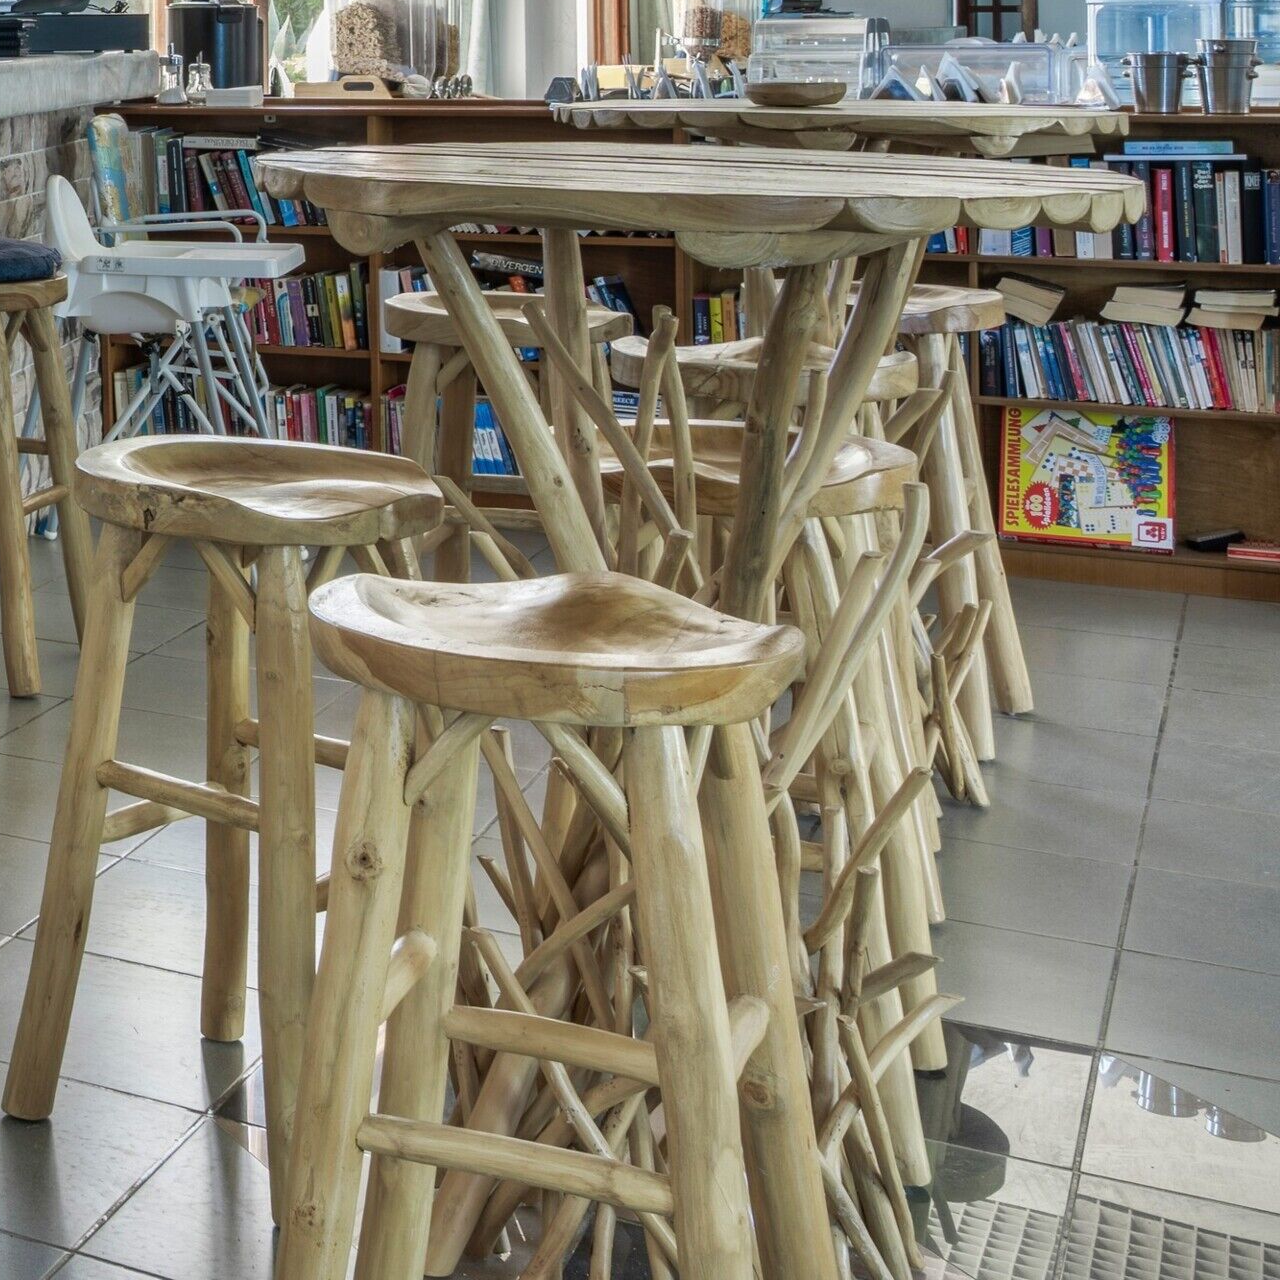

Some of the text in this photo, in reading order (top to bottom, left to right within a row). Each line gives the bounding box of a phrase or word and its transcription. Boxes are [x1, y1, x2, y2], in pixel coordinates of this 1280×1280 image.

[490, 258, 544, 275] DIVERGEN
[1006, 407, 1022, 527] SPIELESAMMLUNG
[1029, 494, 1044, 517] 100
